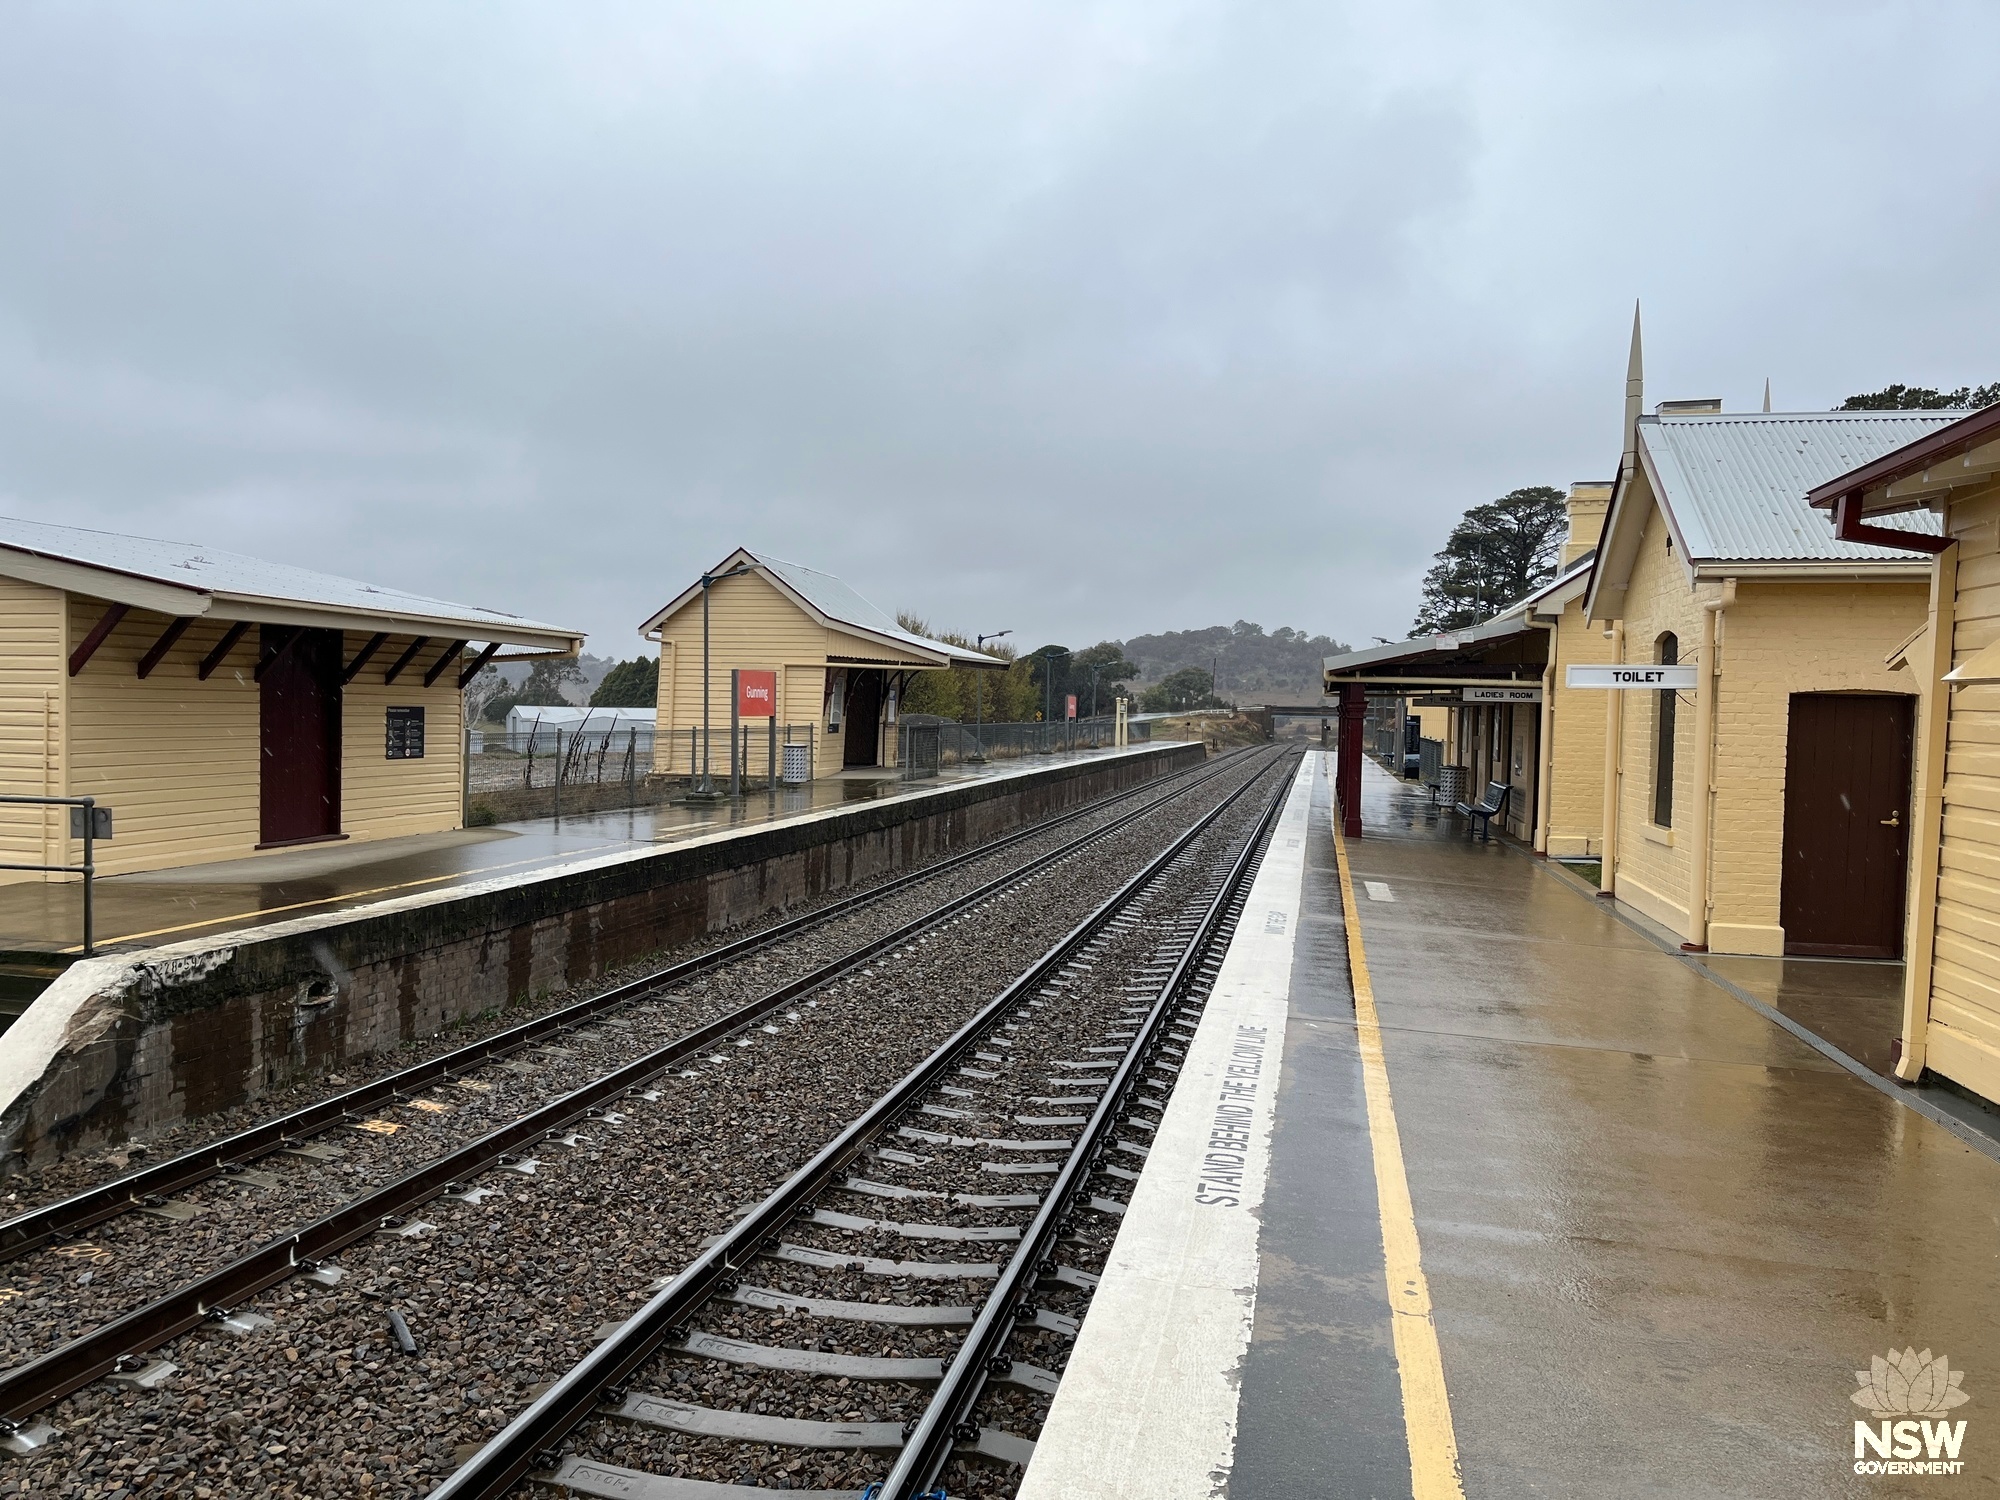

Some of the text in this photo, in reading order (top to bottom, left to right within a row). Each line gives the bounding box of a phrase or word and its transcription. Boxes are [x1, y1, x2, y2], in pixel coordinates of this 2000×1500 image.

[1612, 672, 1665, 683] TOILET
[746, 685, 769, 702] Gunning
[1474, 691, 1504, 699] LADIES
[1194, 1025, 1267, 1208] STAND BEHIND THE YELLOW LINE
